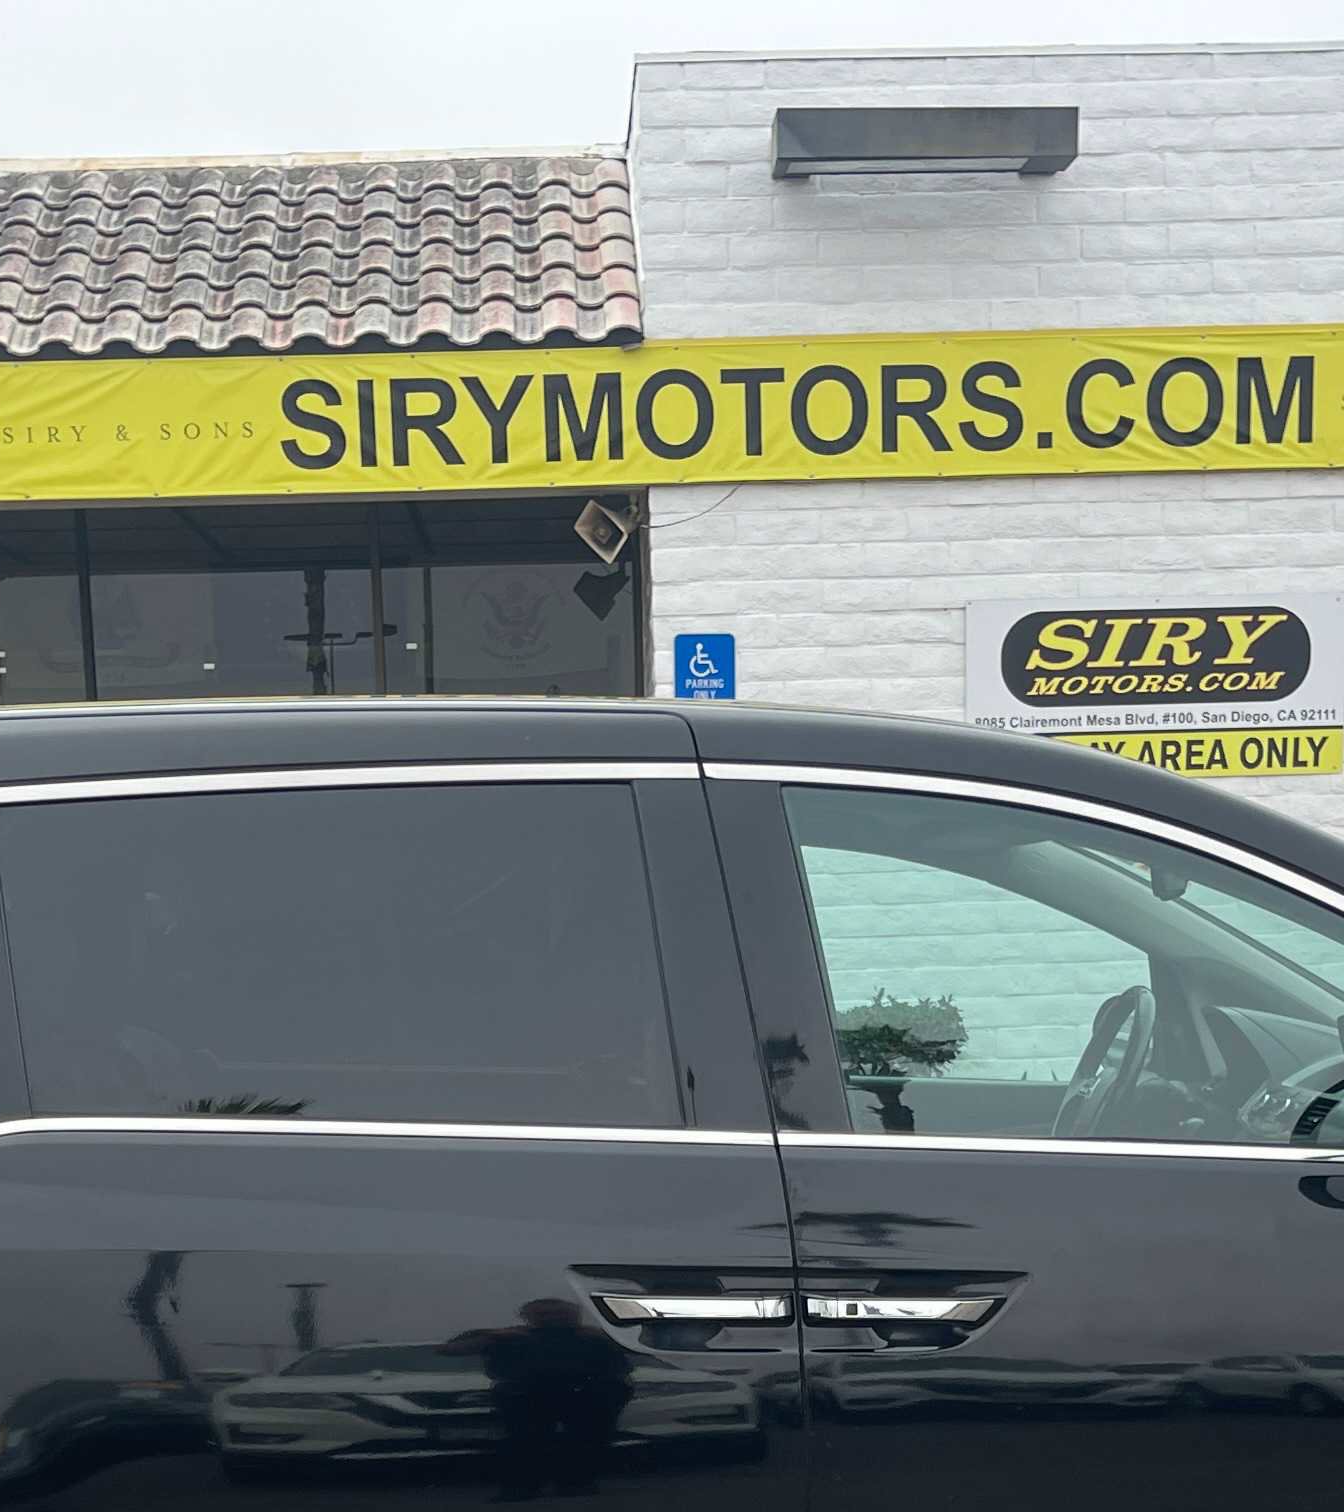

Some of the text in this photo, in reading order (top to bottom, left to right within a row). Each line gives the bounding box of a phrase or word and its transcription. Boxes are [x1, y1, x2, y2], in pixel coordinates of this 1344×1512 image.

[280, 355, 1315, 471] SIRYMOTORS.COM
[2, 420, 255, 445] SIRY & SONS
[1025, 613, 1288, 672] SIRY
[685, 678, 725, 689] PARKING
[1026, 672, 1285, 697] MOTORS.COM
[1009, 715, 1082, 729] Clairemont
[1086, 714, 1121, 727] Mesa
[1162, 711, 1197, 725] #100,
[1201, 711, 1227, 723] San
[1231, 710, 1273, 725] Diego,
[1277, 709, 1298, 722] CA
[1301, 708, 1336, 721] 92111
[1138, 739, 1229, 771] AREA
[1240, 736, 1329, 770] ONLY
